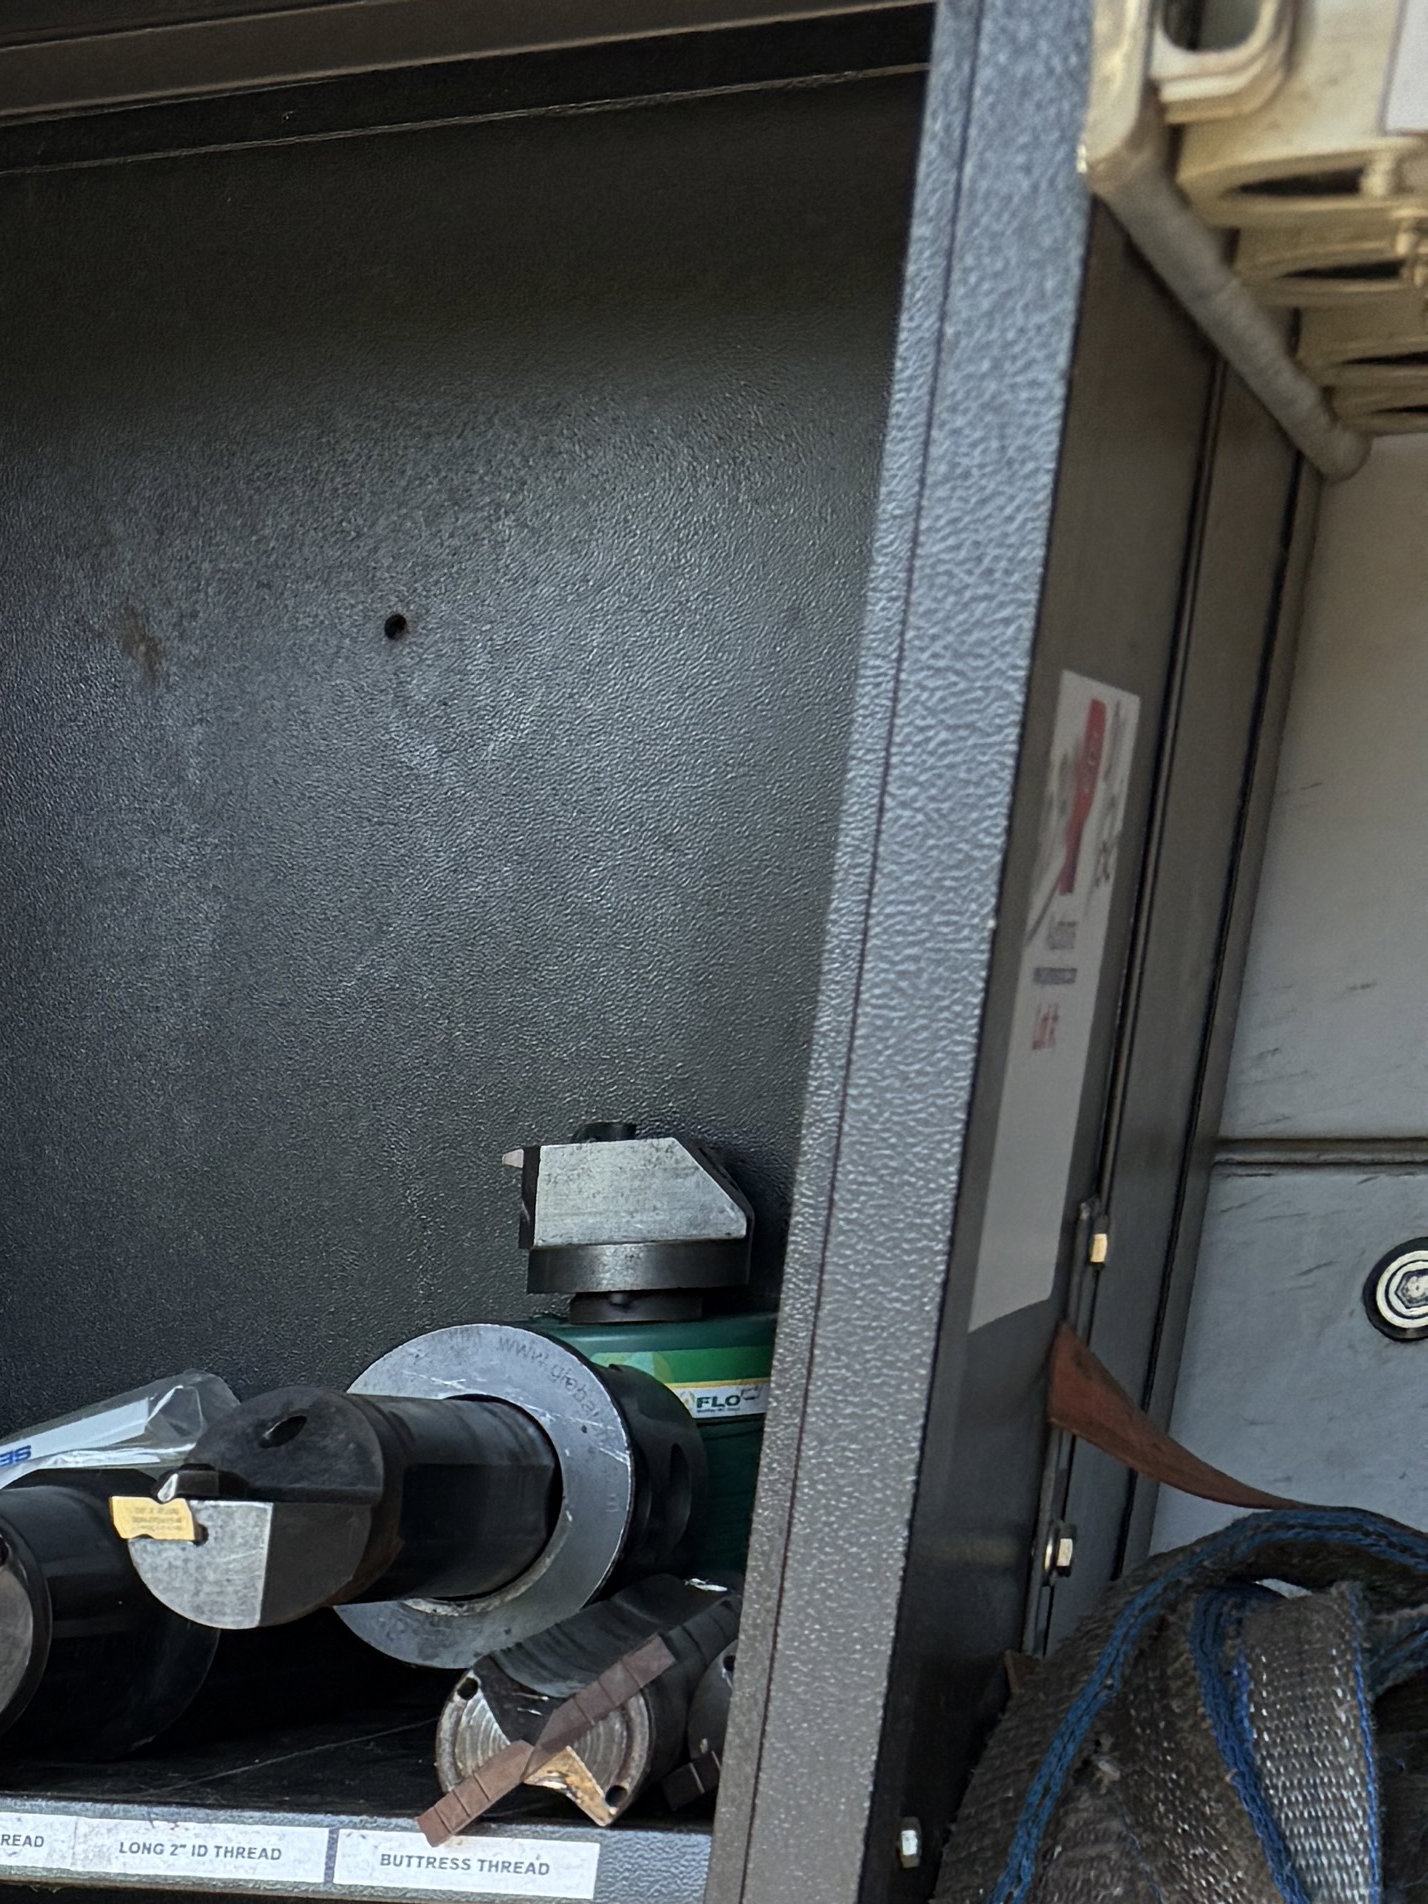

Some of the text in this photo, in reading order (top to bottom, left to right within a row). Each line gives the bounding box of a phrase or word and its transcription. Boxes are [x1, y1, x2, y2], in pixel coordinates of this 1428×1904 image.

[118, 1841, 164, 1856] LONG
[190, 1844, 208, 1858] ID
[212, 1844, 283, 1861] THREAD
[380, 1852, 551, 1877] BUTTRESS THREAD
